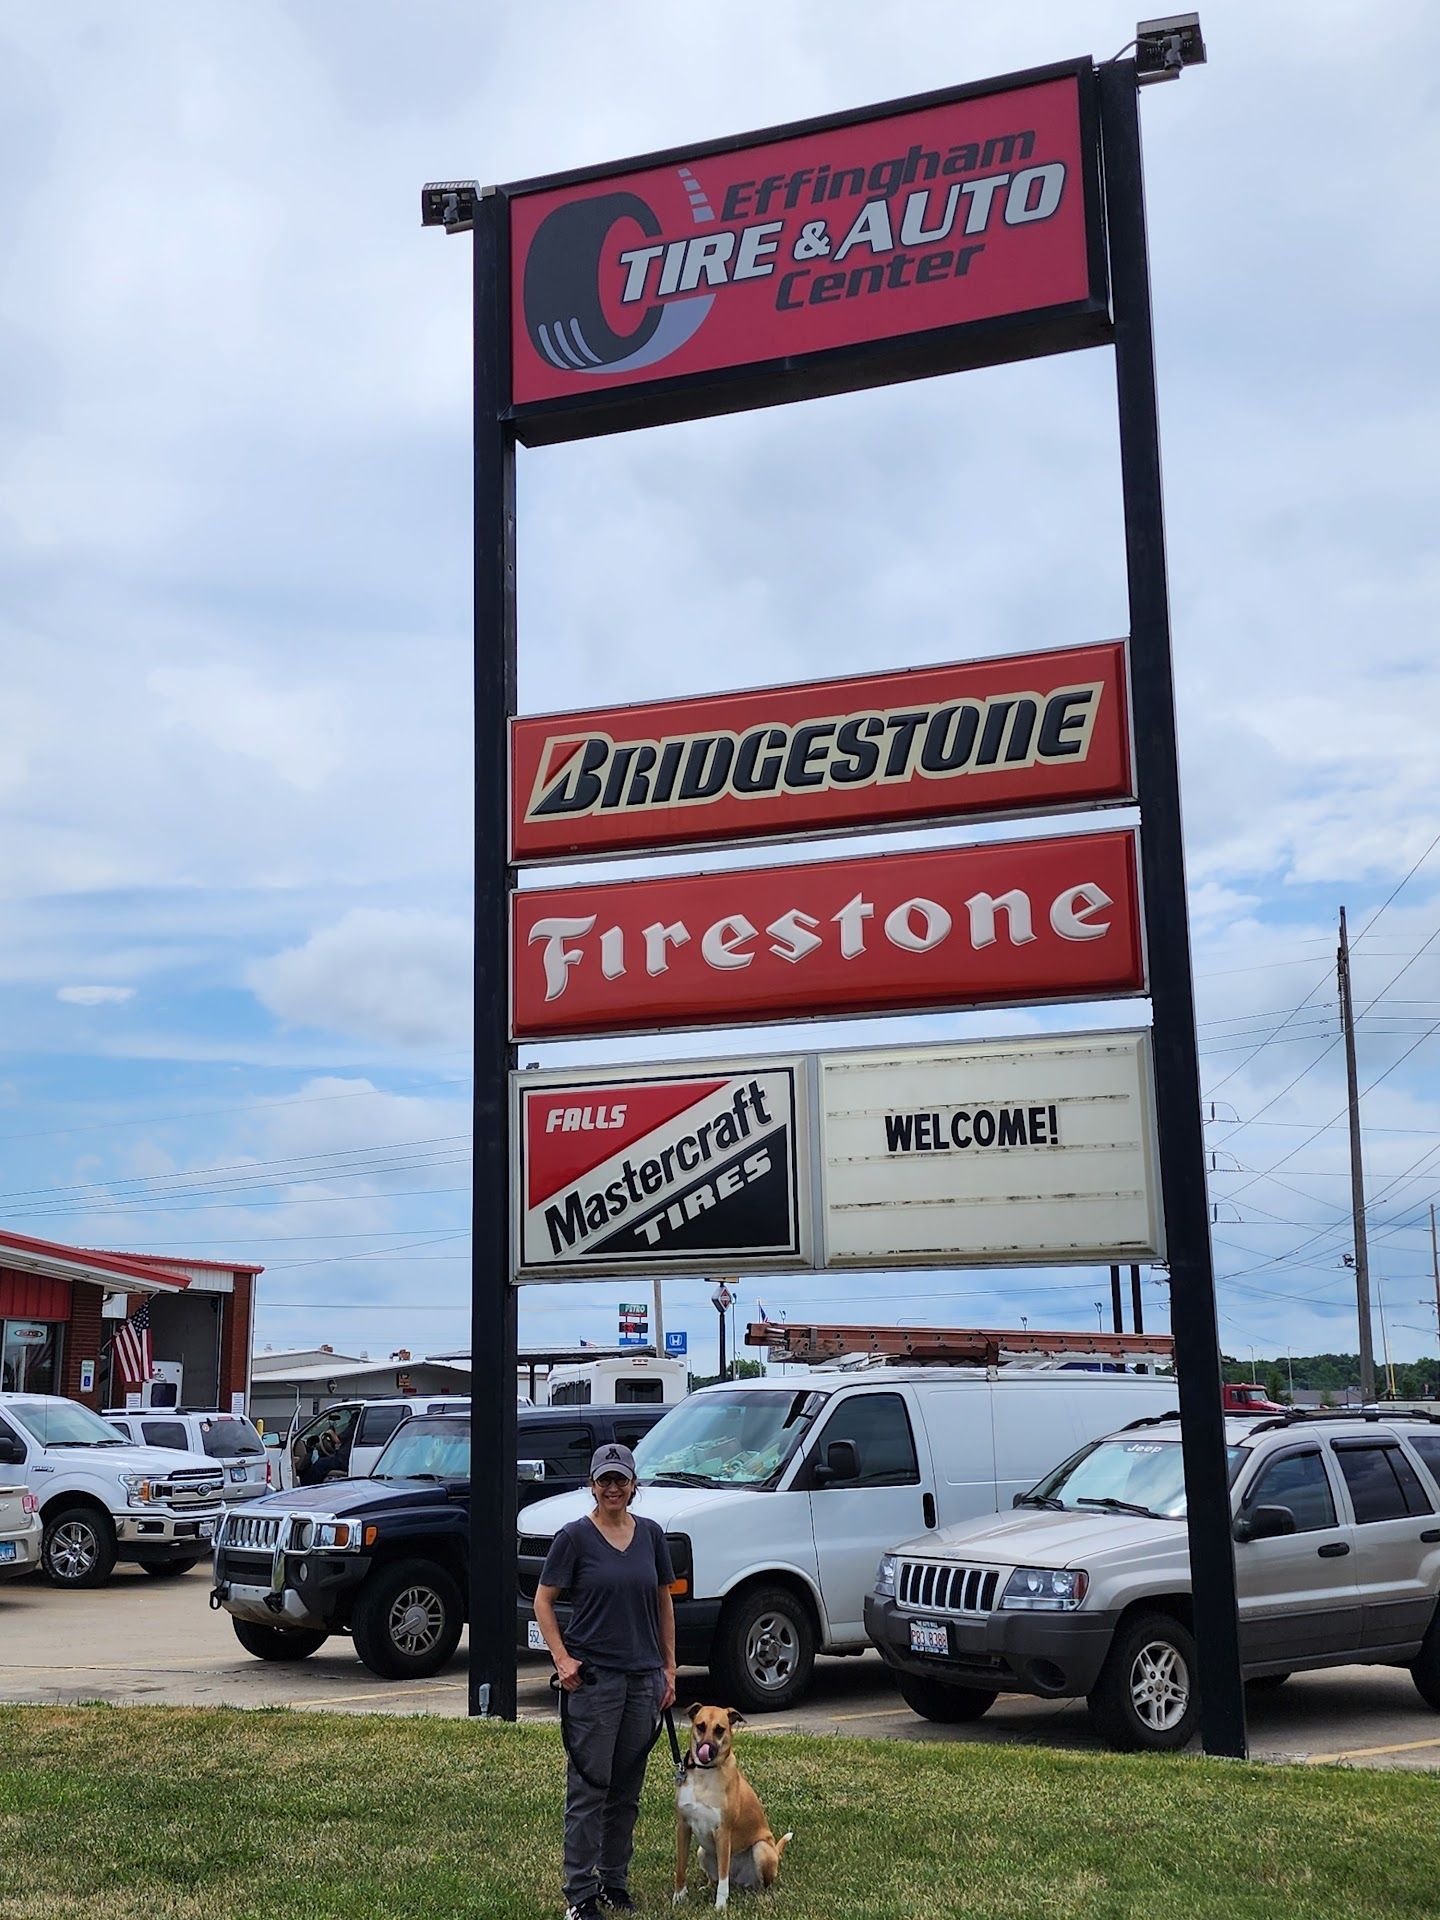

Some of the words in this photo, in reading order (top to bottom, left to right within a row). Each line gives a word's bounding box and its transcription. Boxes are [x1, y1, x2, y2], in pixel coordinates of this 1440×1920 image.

[720, 129, 1036, 222] Effingham
[619, 220, 784, 304] TIRE
[793, 219, 830, 261] &
[834, 161, 1067, 262] AUTO
[775, 243, 986, 312] Center
[526, 685, 1101, 821] BRIDGESTONE
[527, 881, 1115, 1003] Firestone
[545, 1104, 627, 1133] FALLS
[884, 1104, 1059, 1153] WELCOME!
[544, 1080, 773, 1257] Mastercraft
[634, 1147, 772, 1246] TIRES
[624, 1304, 646, 1313] PETRO
[1126, 1443, 1163, 1454] Jeep
